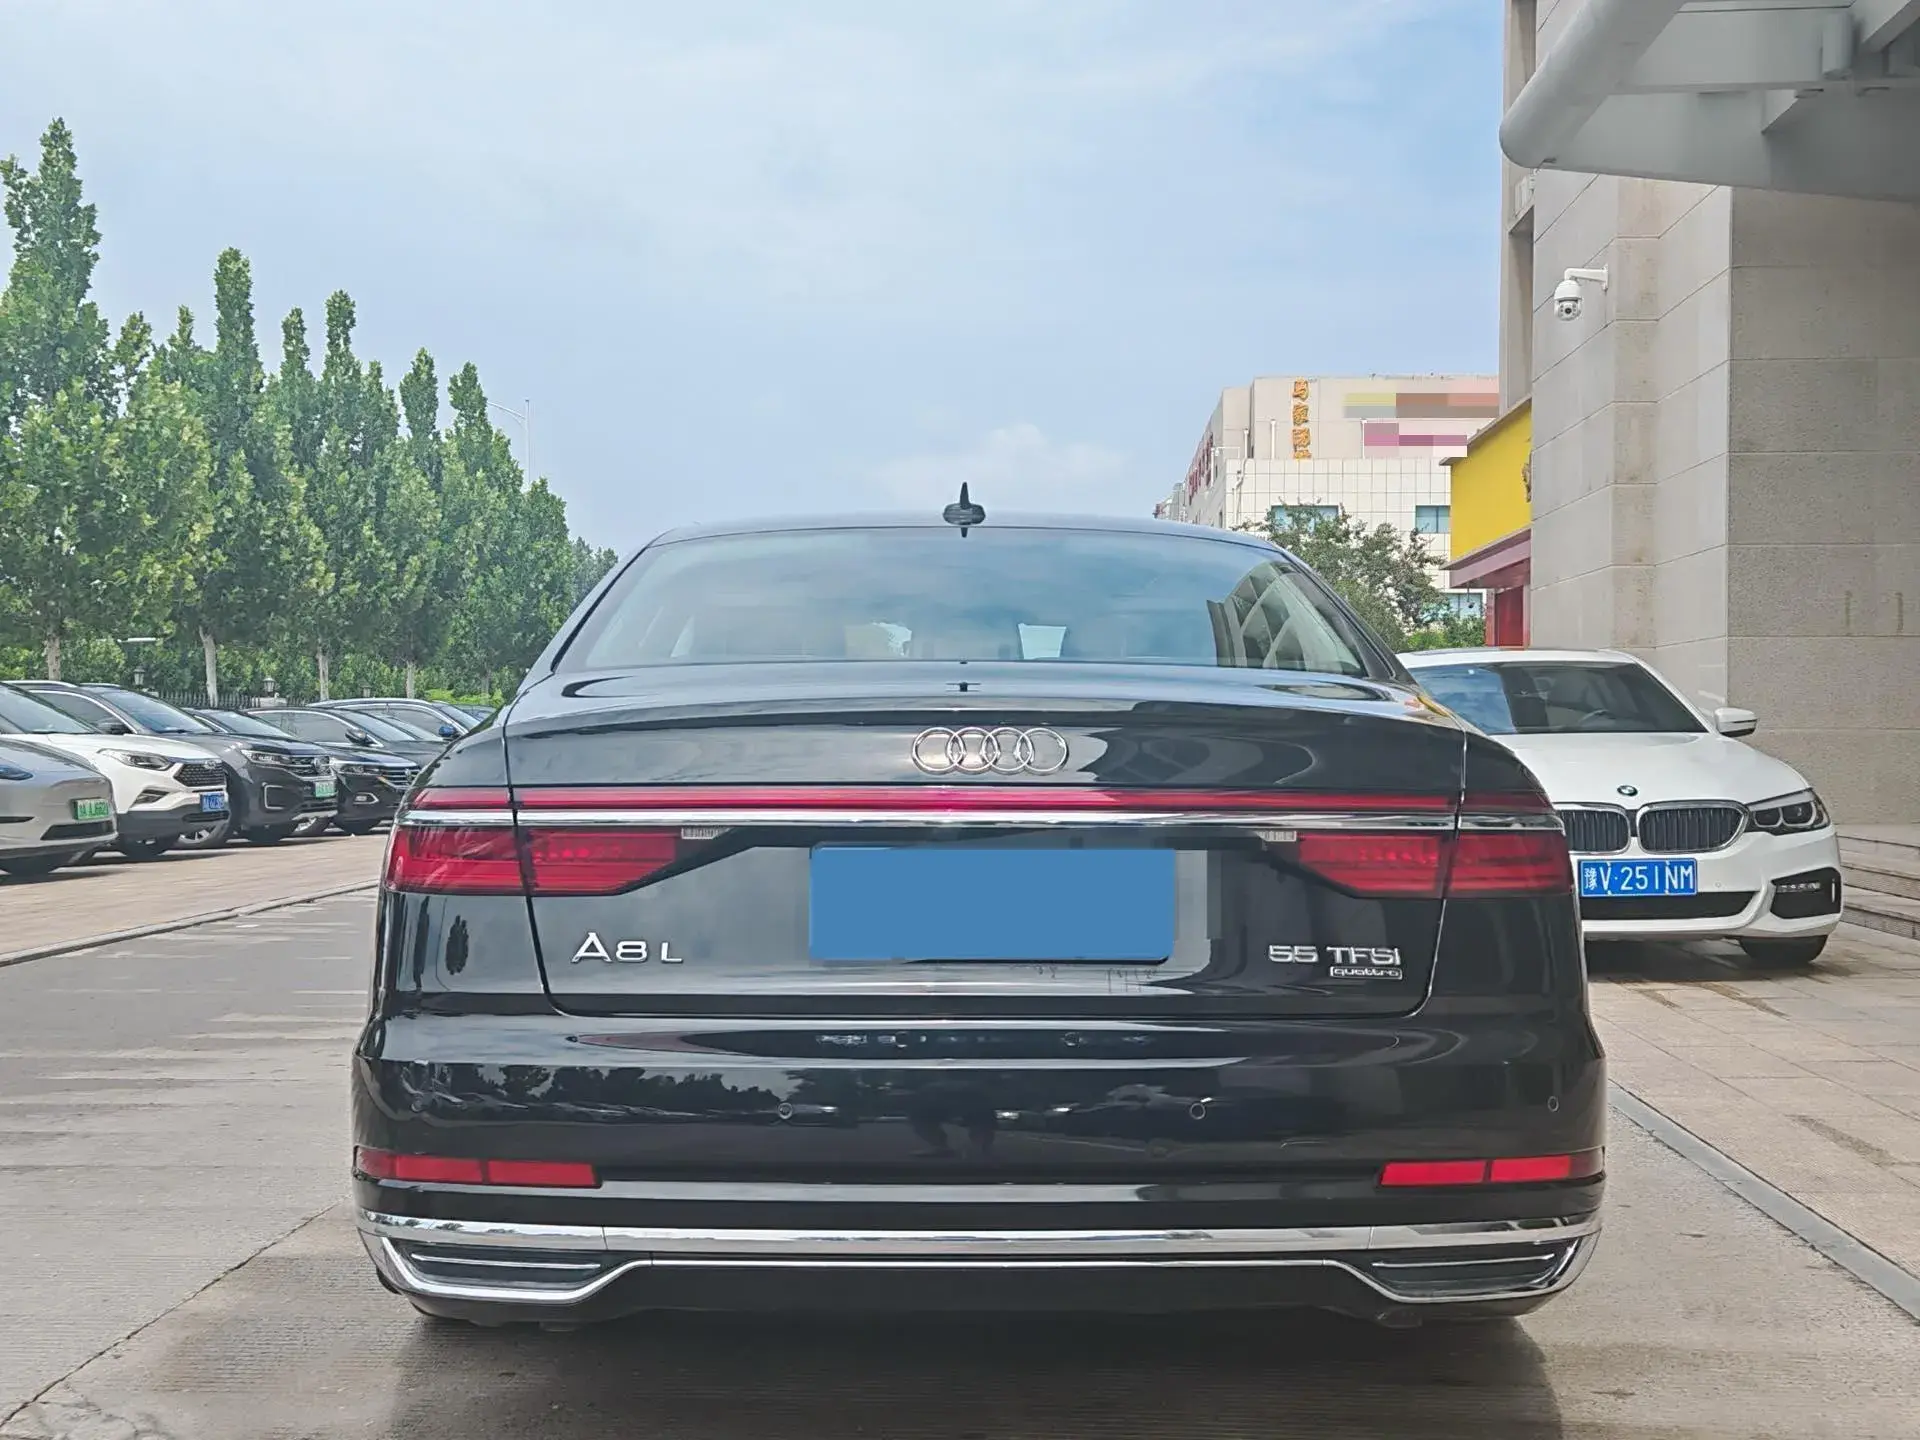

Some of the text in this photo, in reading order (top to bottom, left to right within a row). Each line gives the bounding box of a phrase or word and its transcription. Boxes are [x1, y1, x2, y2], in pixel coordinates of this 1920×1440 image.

[570, 931, 684, 964] A8 L
[1268, 944, 1402, 966] 55 TFSI
[1334, 966, 1400, 977] quattro
